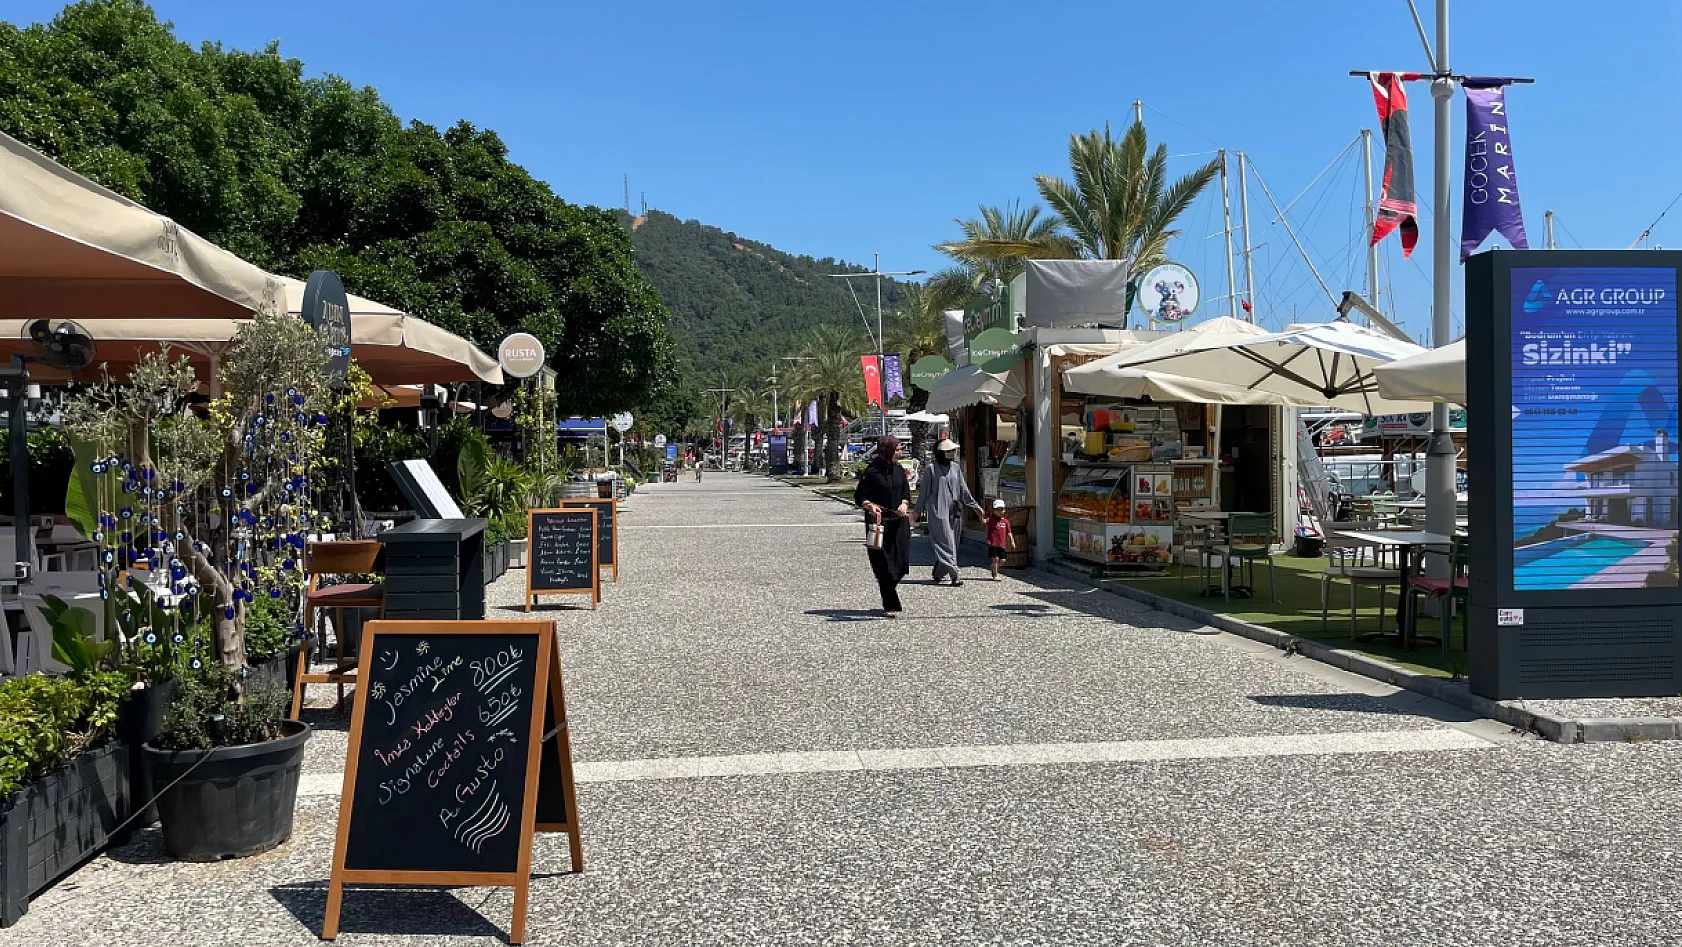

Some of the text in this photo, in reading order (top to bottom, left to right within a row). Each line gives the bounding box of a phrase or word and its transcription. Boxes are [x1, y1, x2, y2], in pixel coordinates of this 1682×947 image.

[1470, 130, 1488, 204] GÖCEK
[1556, 289, 1665, 305] AGR GROUP
[1565, 308, 1645, 316] www.agrgroup.com.tr
[505, 348, 537, 358] RUSTA
[1173, 478, 1190, 492] BAR
[384, 656, 443, 726] Jasmine
[378, 738, 444, 805] Signature
[455, 748, 504, 803] Gusto
